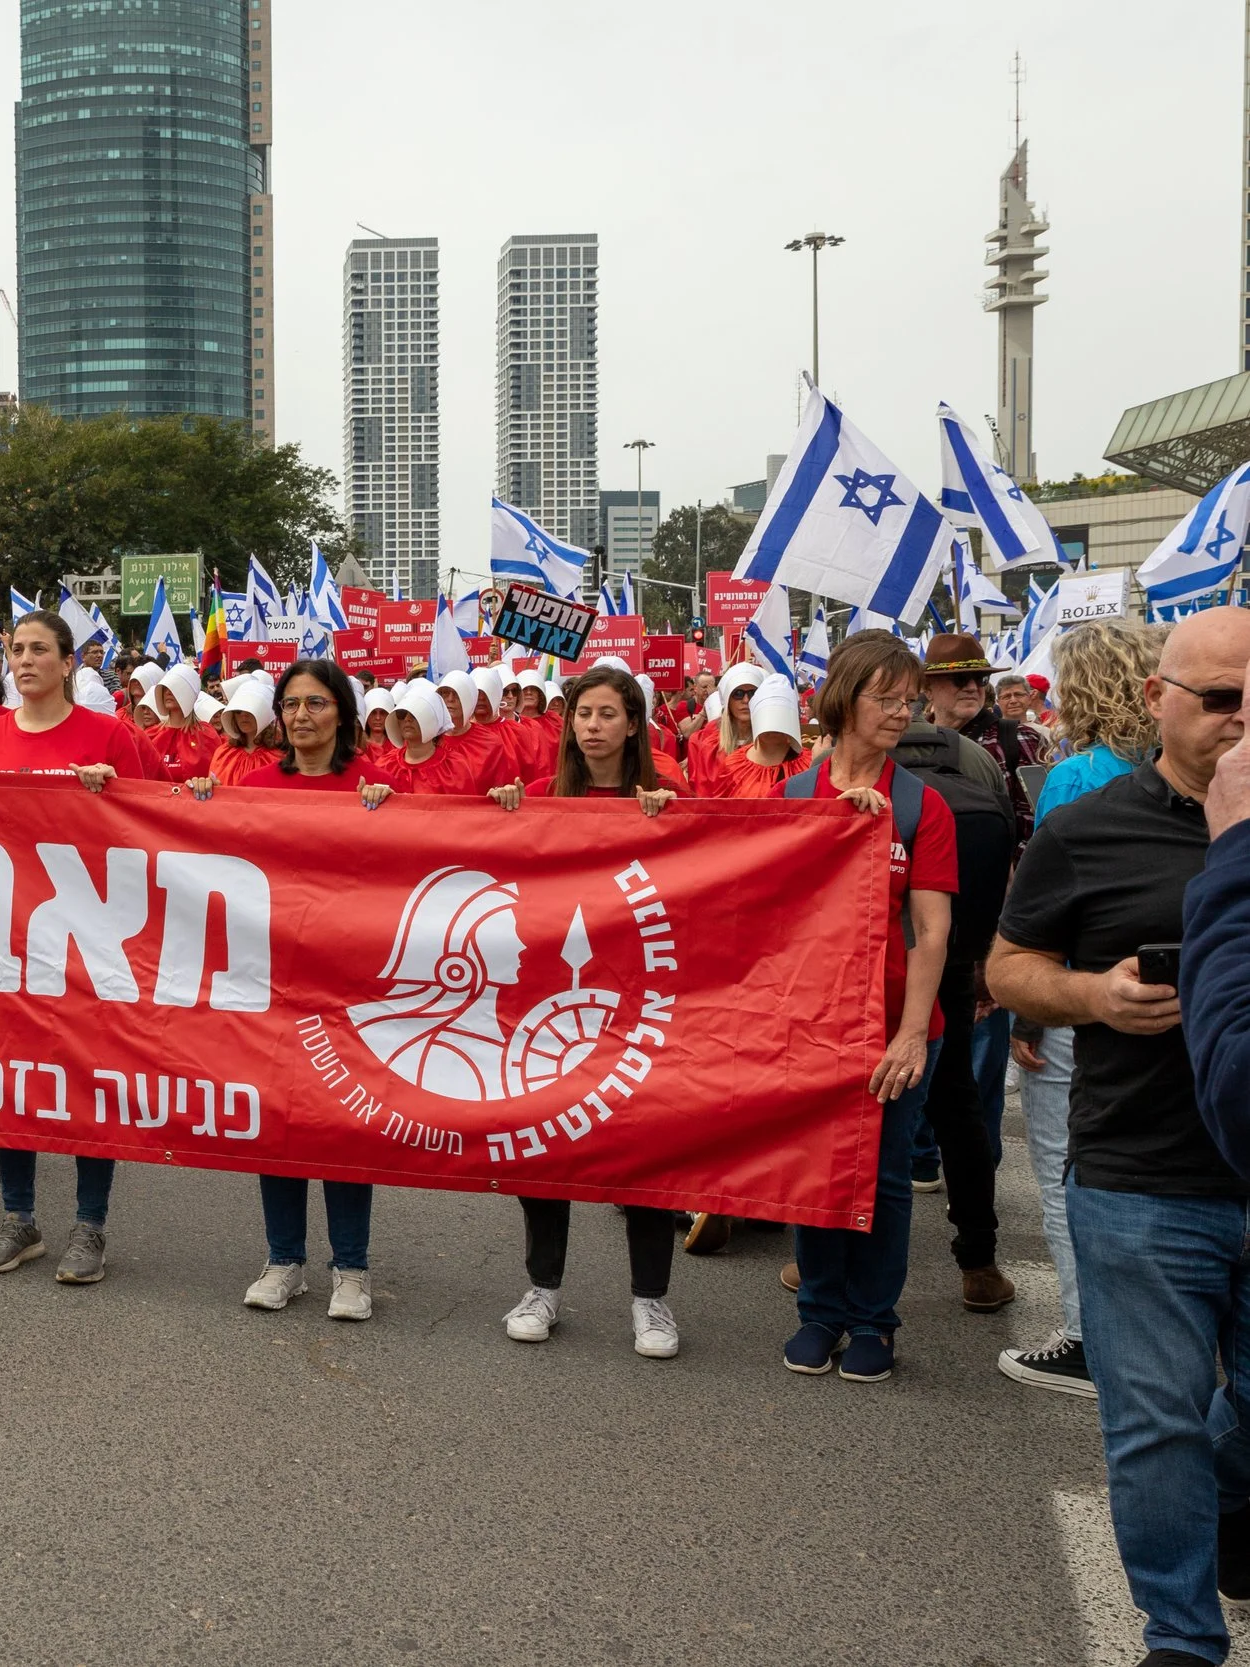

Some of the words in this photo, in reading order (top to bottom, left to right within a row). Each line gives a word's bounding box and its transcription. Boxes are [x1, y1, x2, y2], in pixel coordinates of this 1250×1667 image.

[129, 577, 159, 586] Ayalon
[166, 576, 192, 584] South
[130, 563, 155, 573] דרום
[162, 561, 190, 573] אילון
[511, 588, 591, 634] חופשי
[1061, 602, 1119, 619] ROLEX
[385, 624, 411, 633] הנשים
[498, 610, 582, 659] בארצנו
[614, 638, 636, 646] אנחנו
[342, 649, 367, 659] הנשים
[648, 658, 676, 669] מאבק
[613, 859, 680, 973] בונות
[295, 1014, 351, 1090] השטח
[485, 989, 677, 1163] אלטרנטיבה
[92, 1068, 261, 1141] פגיעה
[339, 1082, 384, 1126] את
[379, 1110, 464, 1157] משנות
